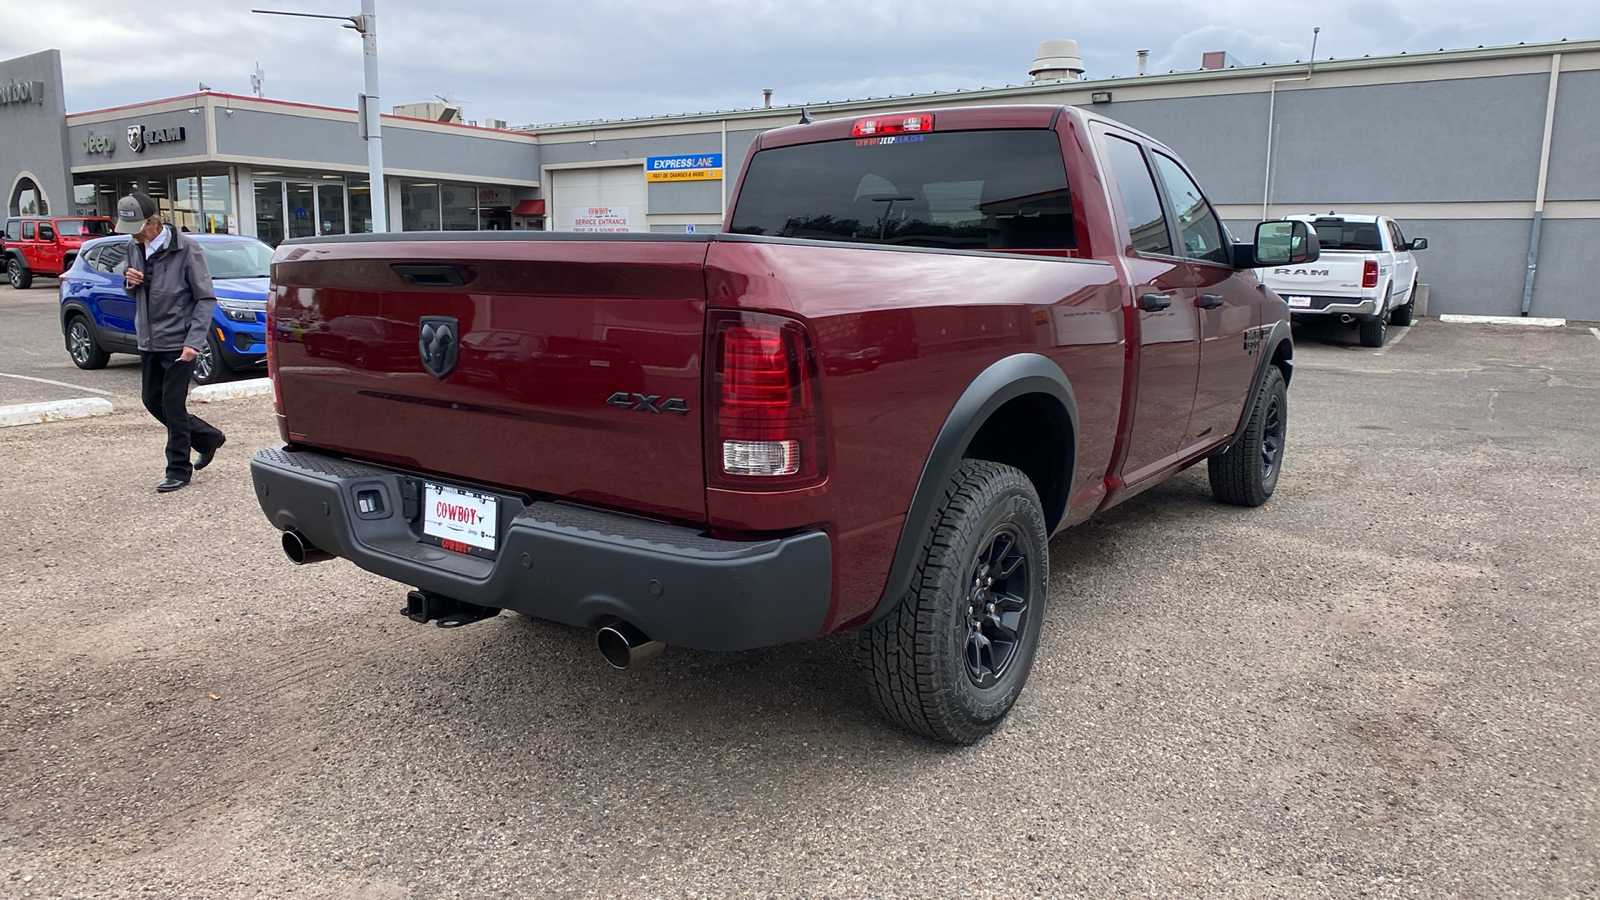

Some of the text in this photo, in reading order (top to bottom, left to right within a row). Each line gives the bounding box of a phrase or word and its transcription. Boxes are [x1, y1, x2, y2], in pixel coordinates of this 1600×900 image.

[81, 129, 115, 158] Jeep
[143, 126, 186, 144] RAM
[1274, 268, 1329, 276] RAM
[436, 501, 477, 525] COWBOY
